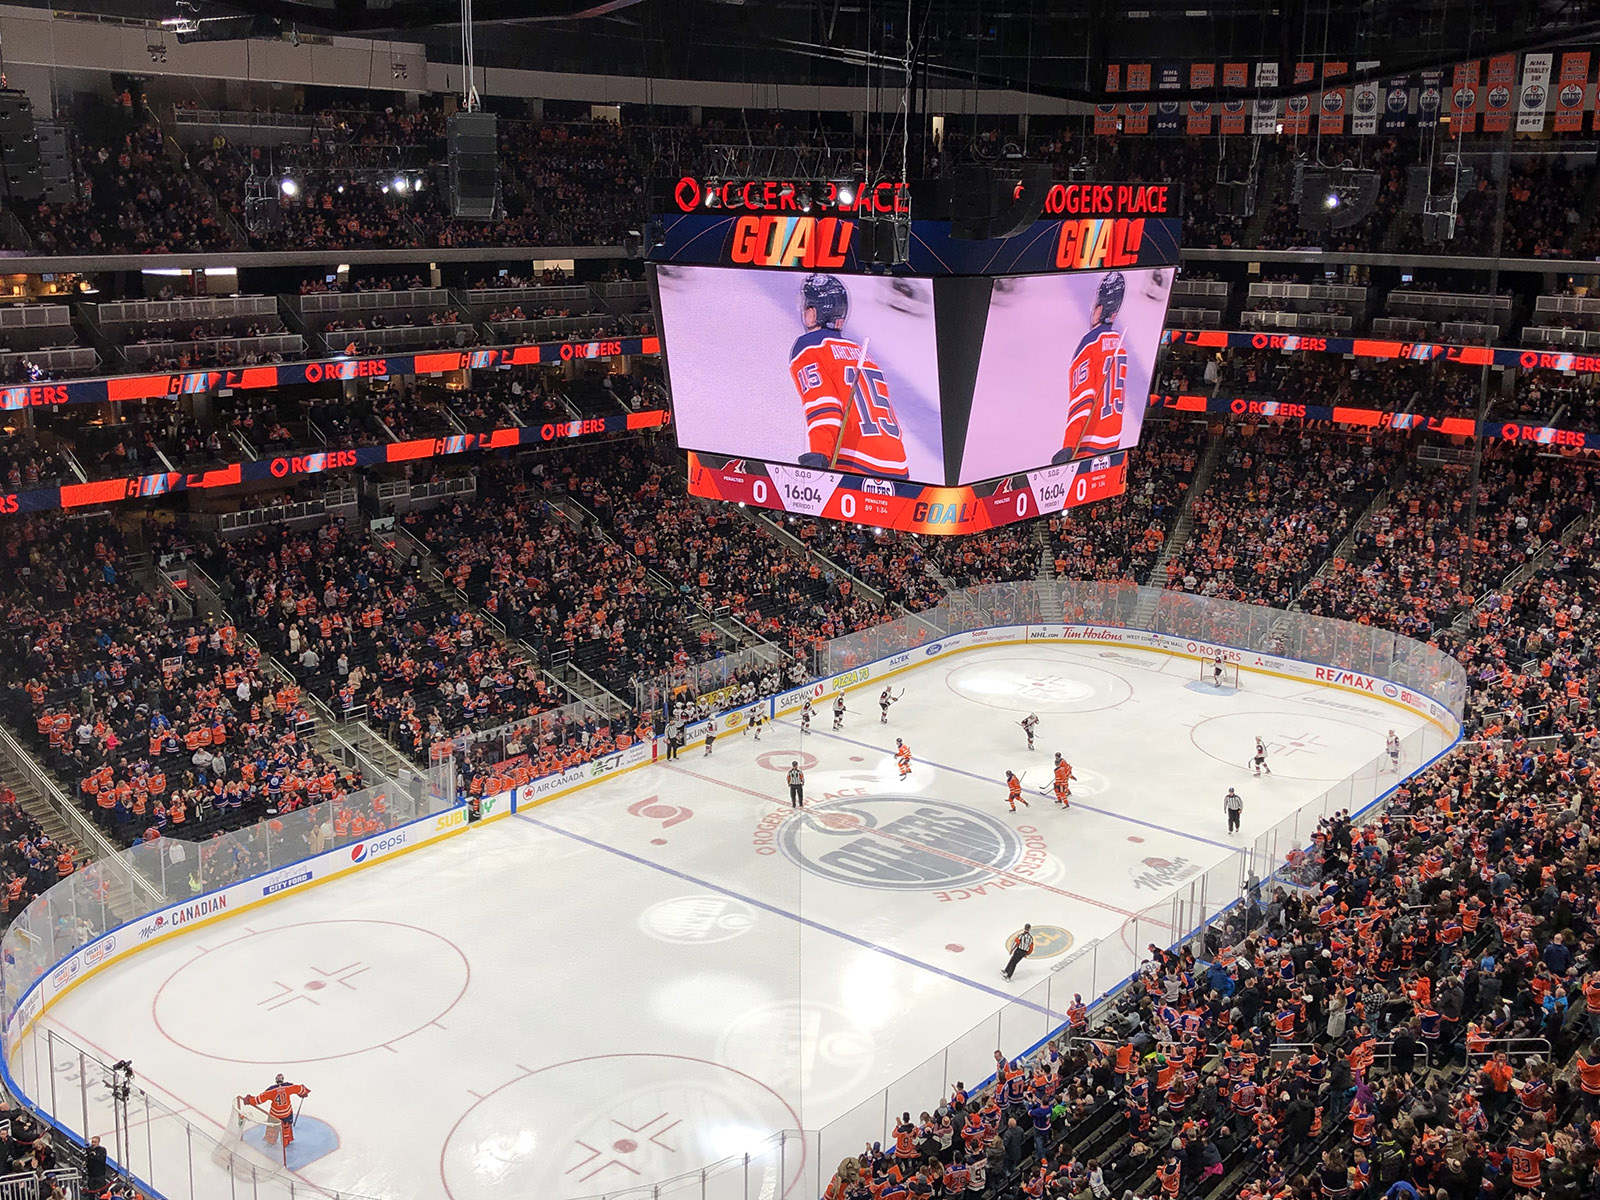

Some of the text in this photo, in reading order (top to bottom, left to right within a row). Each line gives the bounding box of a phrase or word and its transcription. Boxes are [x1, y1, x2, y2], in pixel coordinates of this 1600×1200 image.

[1117, 186, 1168, 213] PLACE
[731, 216, 853, 268] GOAL!
[1056, 218, 1146, 269] GOAL!
[575, 341, 621, 358] ROGERS
[1270, 335, 1327, 351] ROGERS
[325, 360, 387, 380] ROGERS
[797, 362, 823, 396] 15
[1071, 357, 1091, 392] 15
[1100, 354, 1128, 420] 15
[844, 366, 902, 440] 15
[1249, 400, 1306, 418] ROGERS
[556, 419, 605, 437] ROGERS
[1522, 425, 1585, 447] ROGERS
[292, 450, 357, 473] ROGERS
[774, 467, 780, 475] 0
[753, 480, 767, 503] 0
[784, 484, 822, 503] 16:04
[1040, 483, 1065, 502] 16:04
[1076, 478, 1086, 501] 0
[841, 494, 856, 518] 0
[913, 501, 977, 524] GOAL!
[1016, 493, 1027, 517] 0
[1063, 626, 1122, 641] Tim Hortons
[833, 667, 869, 691] PIZZA 73
[1315, 667, 1374, 691] RE/MAX
[780, 687, 814, 708] SAFEWAY
[1400, 690, 1411, 703] 80
[536, 771, 585, 794] AIR CANADA
[370, 831, 406, 856] pepsi
[269, 874, 307, 893] CITY FORD
[138, 895, 226, 939] Molson CANADIAN
[1380, 960, 1394, 972] 97
[1185, 1019, 1200, 1031] 97
[274, 1092, 287, 1106] 41
[1012, 1081, 1024, 1095] 97
[1512, 1156, 1530, 1173] 33
